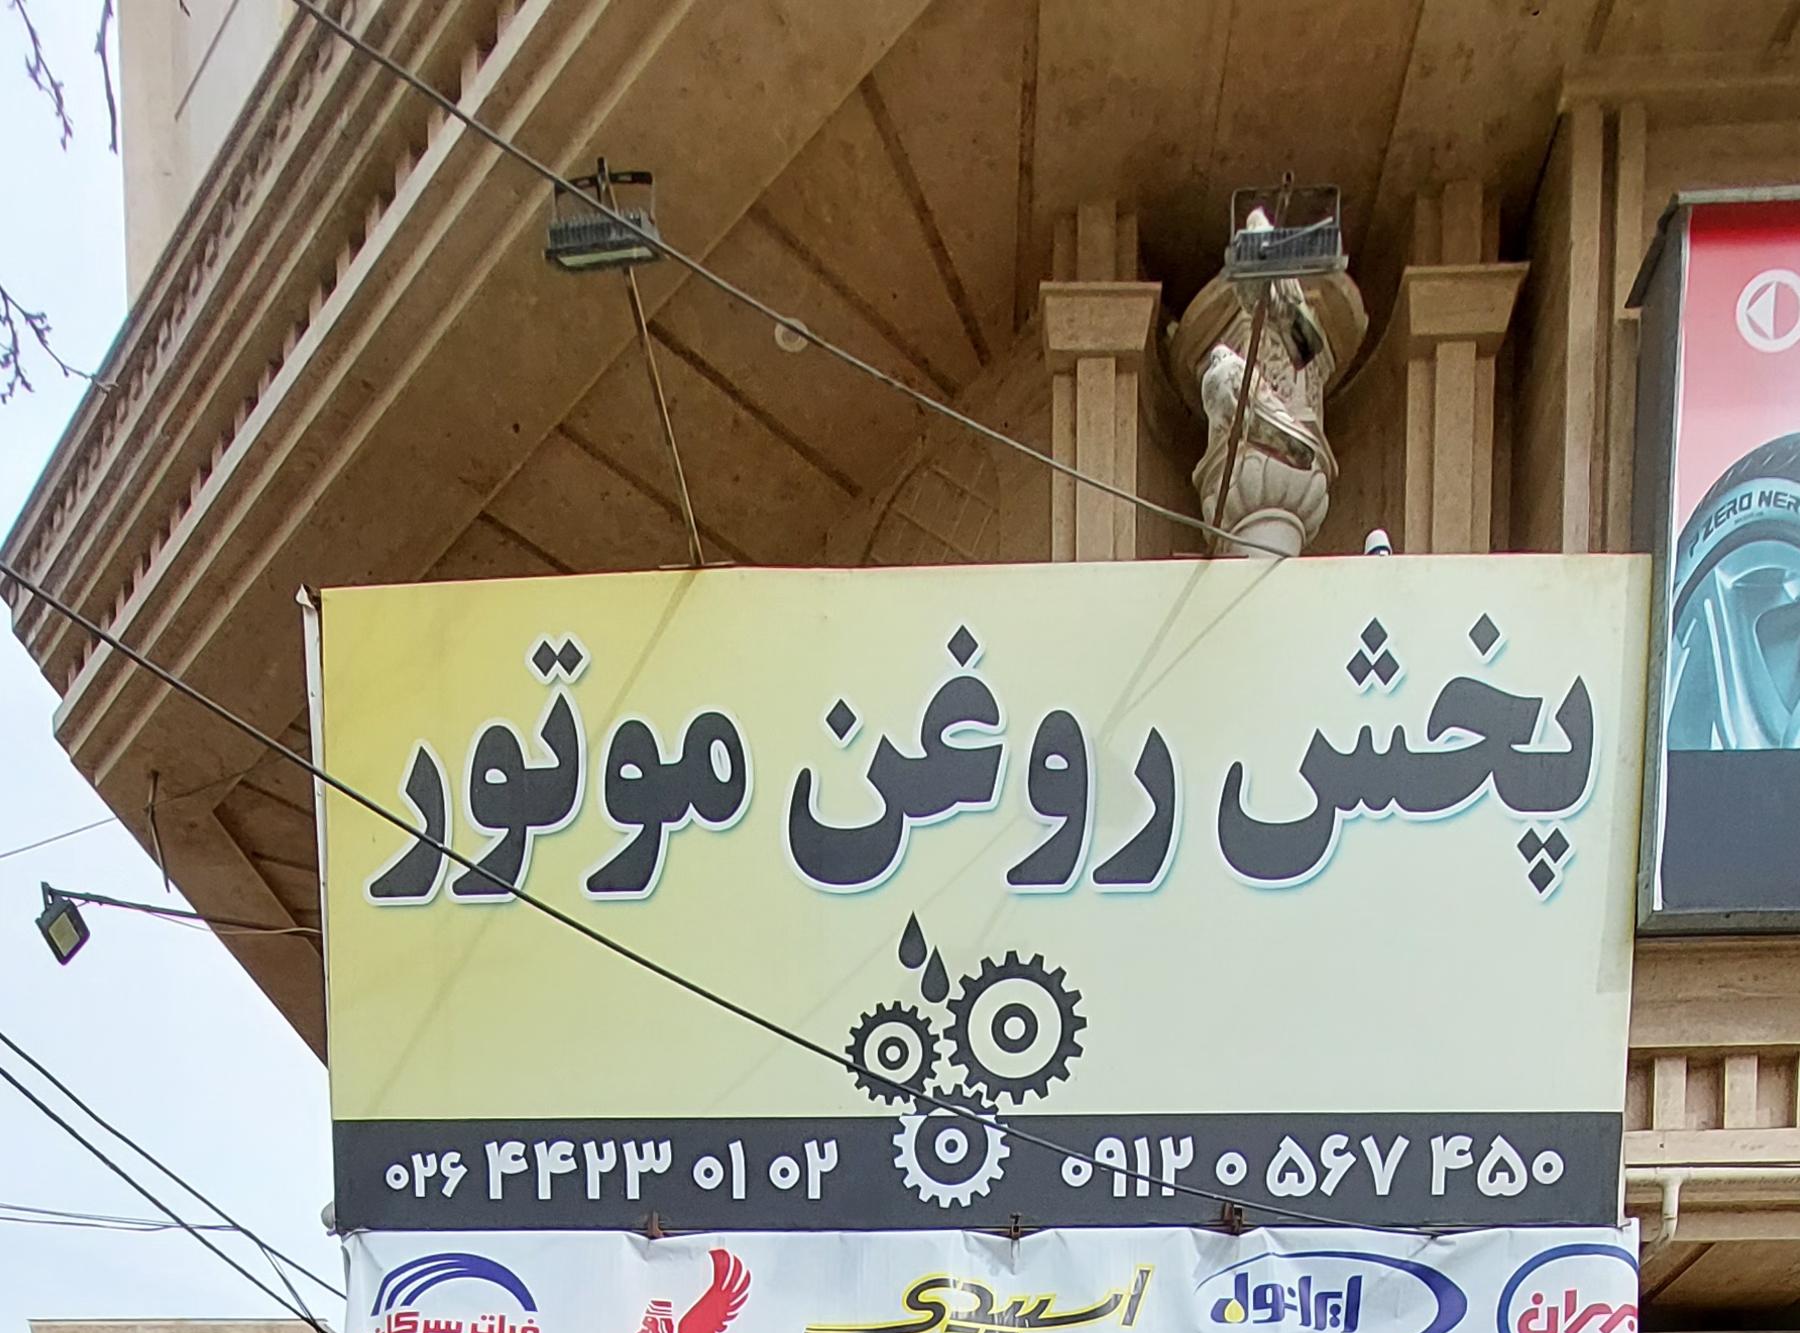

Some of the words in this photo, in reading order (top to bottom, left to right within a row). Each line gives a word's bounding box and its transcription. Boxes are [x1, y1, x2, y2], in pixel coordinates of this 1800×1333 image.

[1702, 491, 1753, 543] ZERO
[368, 637, 748, 899] موتور
[788, 624, 1177, 887] روغن
[1217, 612, 1596, 895] پخش
[385, 1151, 468, 1199] ۰۲۶
[484, 1139, 673, 1200] ۴۴۲۳
[1061, 1134, 1194, 1198] ۰۹۱۲
[1265, 1132, 1410, 1198] ۵۶۷
[1429, 1133, 1565, 1197] ۴۵۰
[1210, 1272, 1363, 1333] ایرانول
